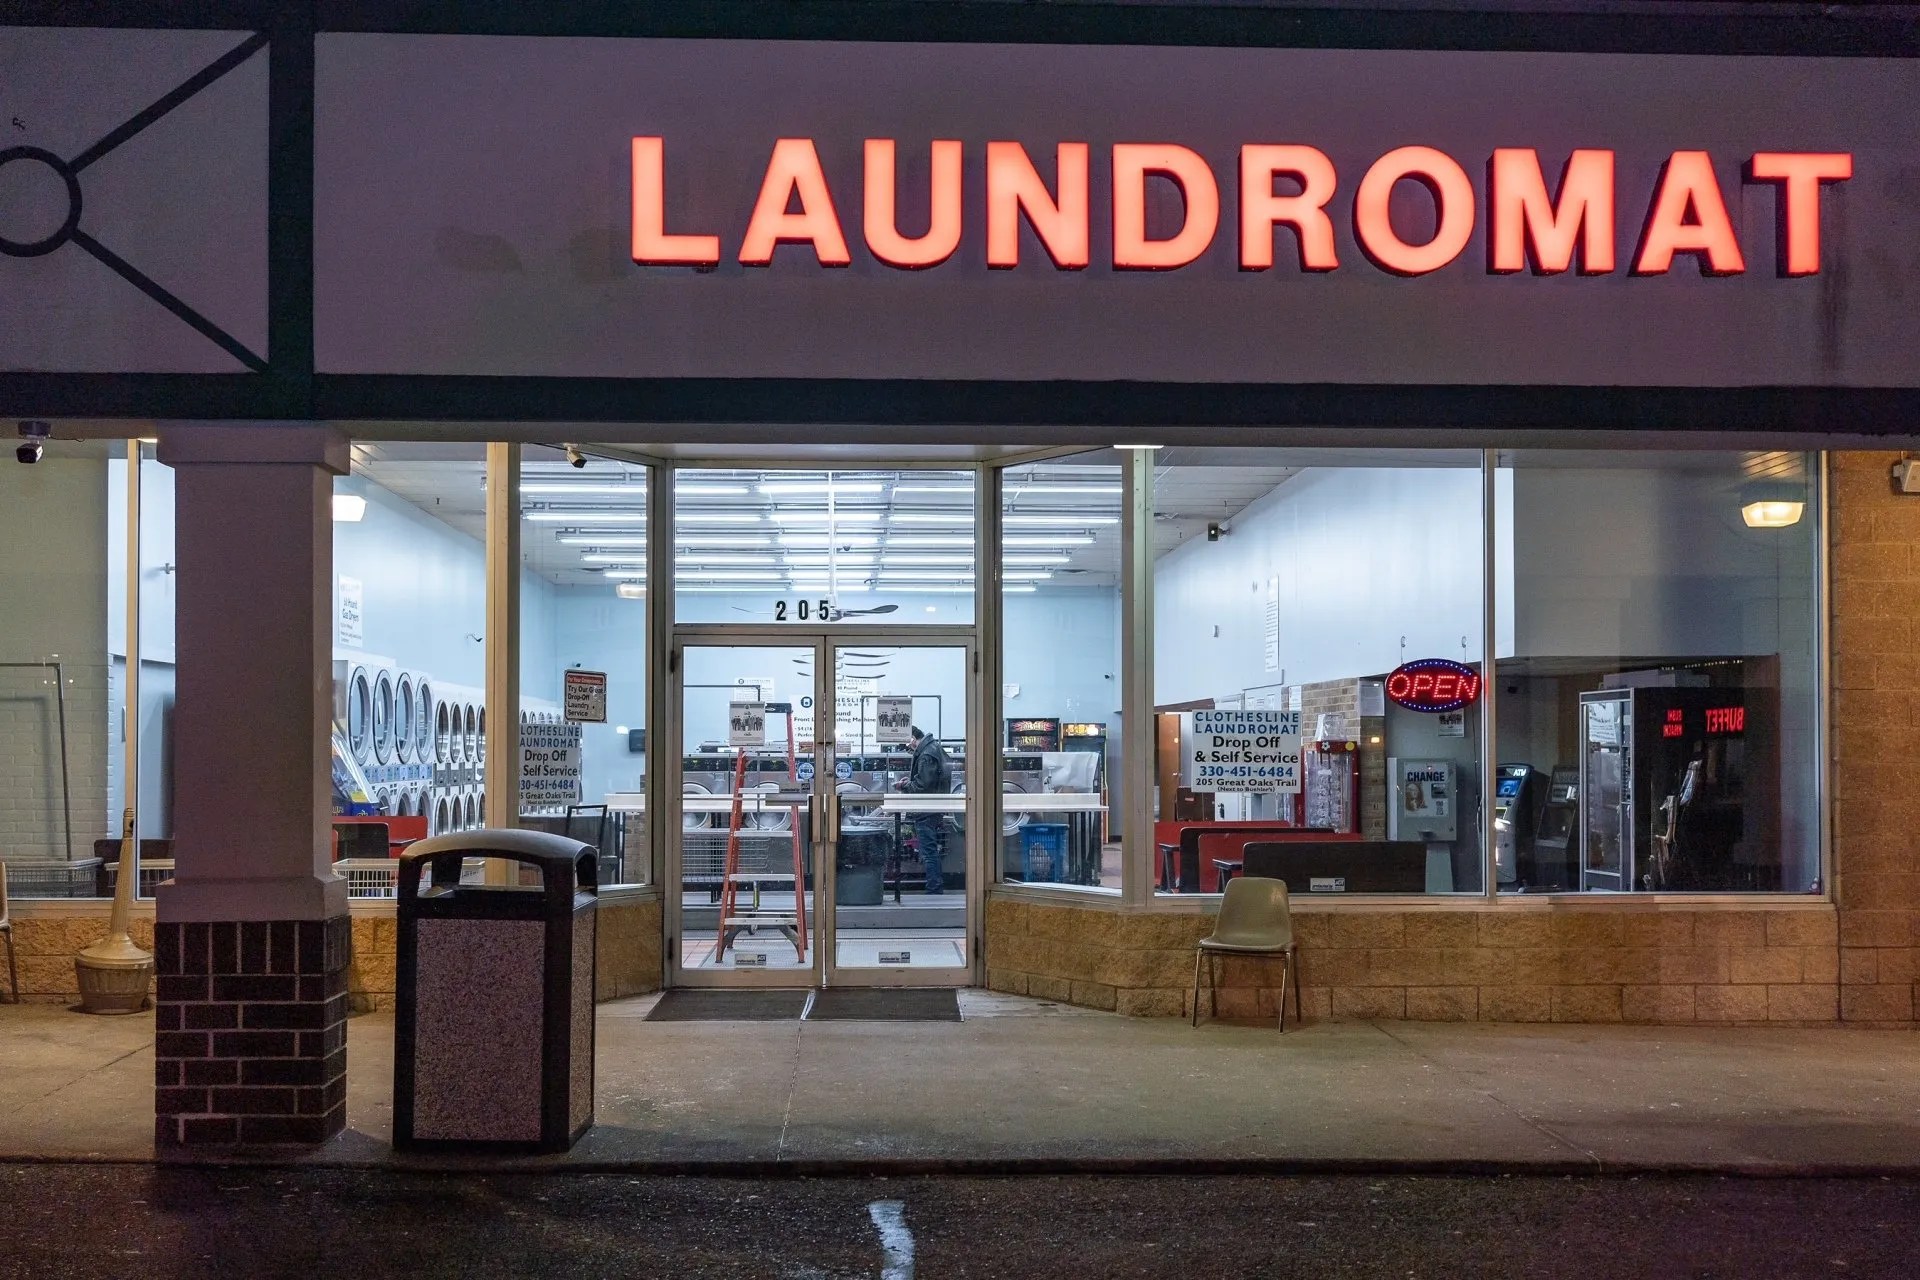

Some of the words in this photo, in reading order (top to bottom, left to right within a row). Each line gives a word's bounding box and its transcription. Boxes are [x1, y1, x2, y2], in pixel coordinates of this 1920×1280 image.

[631, 136, 1854, 277] LAUNDROMAT
[776, 600, 829, 620] 205
[568, 685, 577, 693] Try
[1388, 673, 1478, 699] OPEN
[568, 702, 589, 710] Laundry
[1195, 711, 1299, 723] CLOTHESLINE
[520, 725, 580, 737] LOTHESLINE
[1195, 723, 1299, 735] LAUNDROMAT
[519, 737, 580, 748] AUNDROMAT
[1213, 736, 1250, 751] Drop
[1256, 736, 1280, 748] Off
[524, 749, 549, 765] Drop
[551, 750, 568, 762] Off
[1194, 750, 1206, 763] &
[1211, 751, 1241, 763] Self
[1243, 751, 1299, 764] Service
[523, 765, 541, 776] Self
[543, 765, 578, 777] Service
[1199, 766, 1293, 777] 330-451-6484
[1407, 771, 1445, 782] CHANGE
[520, 779, 574, 790] 30-451-6484
[1196, 778, 1213, 786] 205
[1216, 778, 1245, 786] Great
[1248, 778, 1274, 786] Oaks
[525, 791, 543, 799] Great
[545, 791, 562, 799] Oaks
[562, 791, 576, 799] Trail
